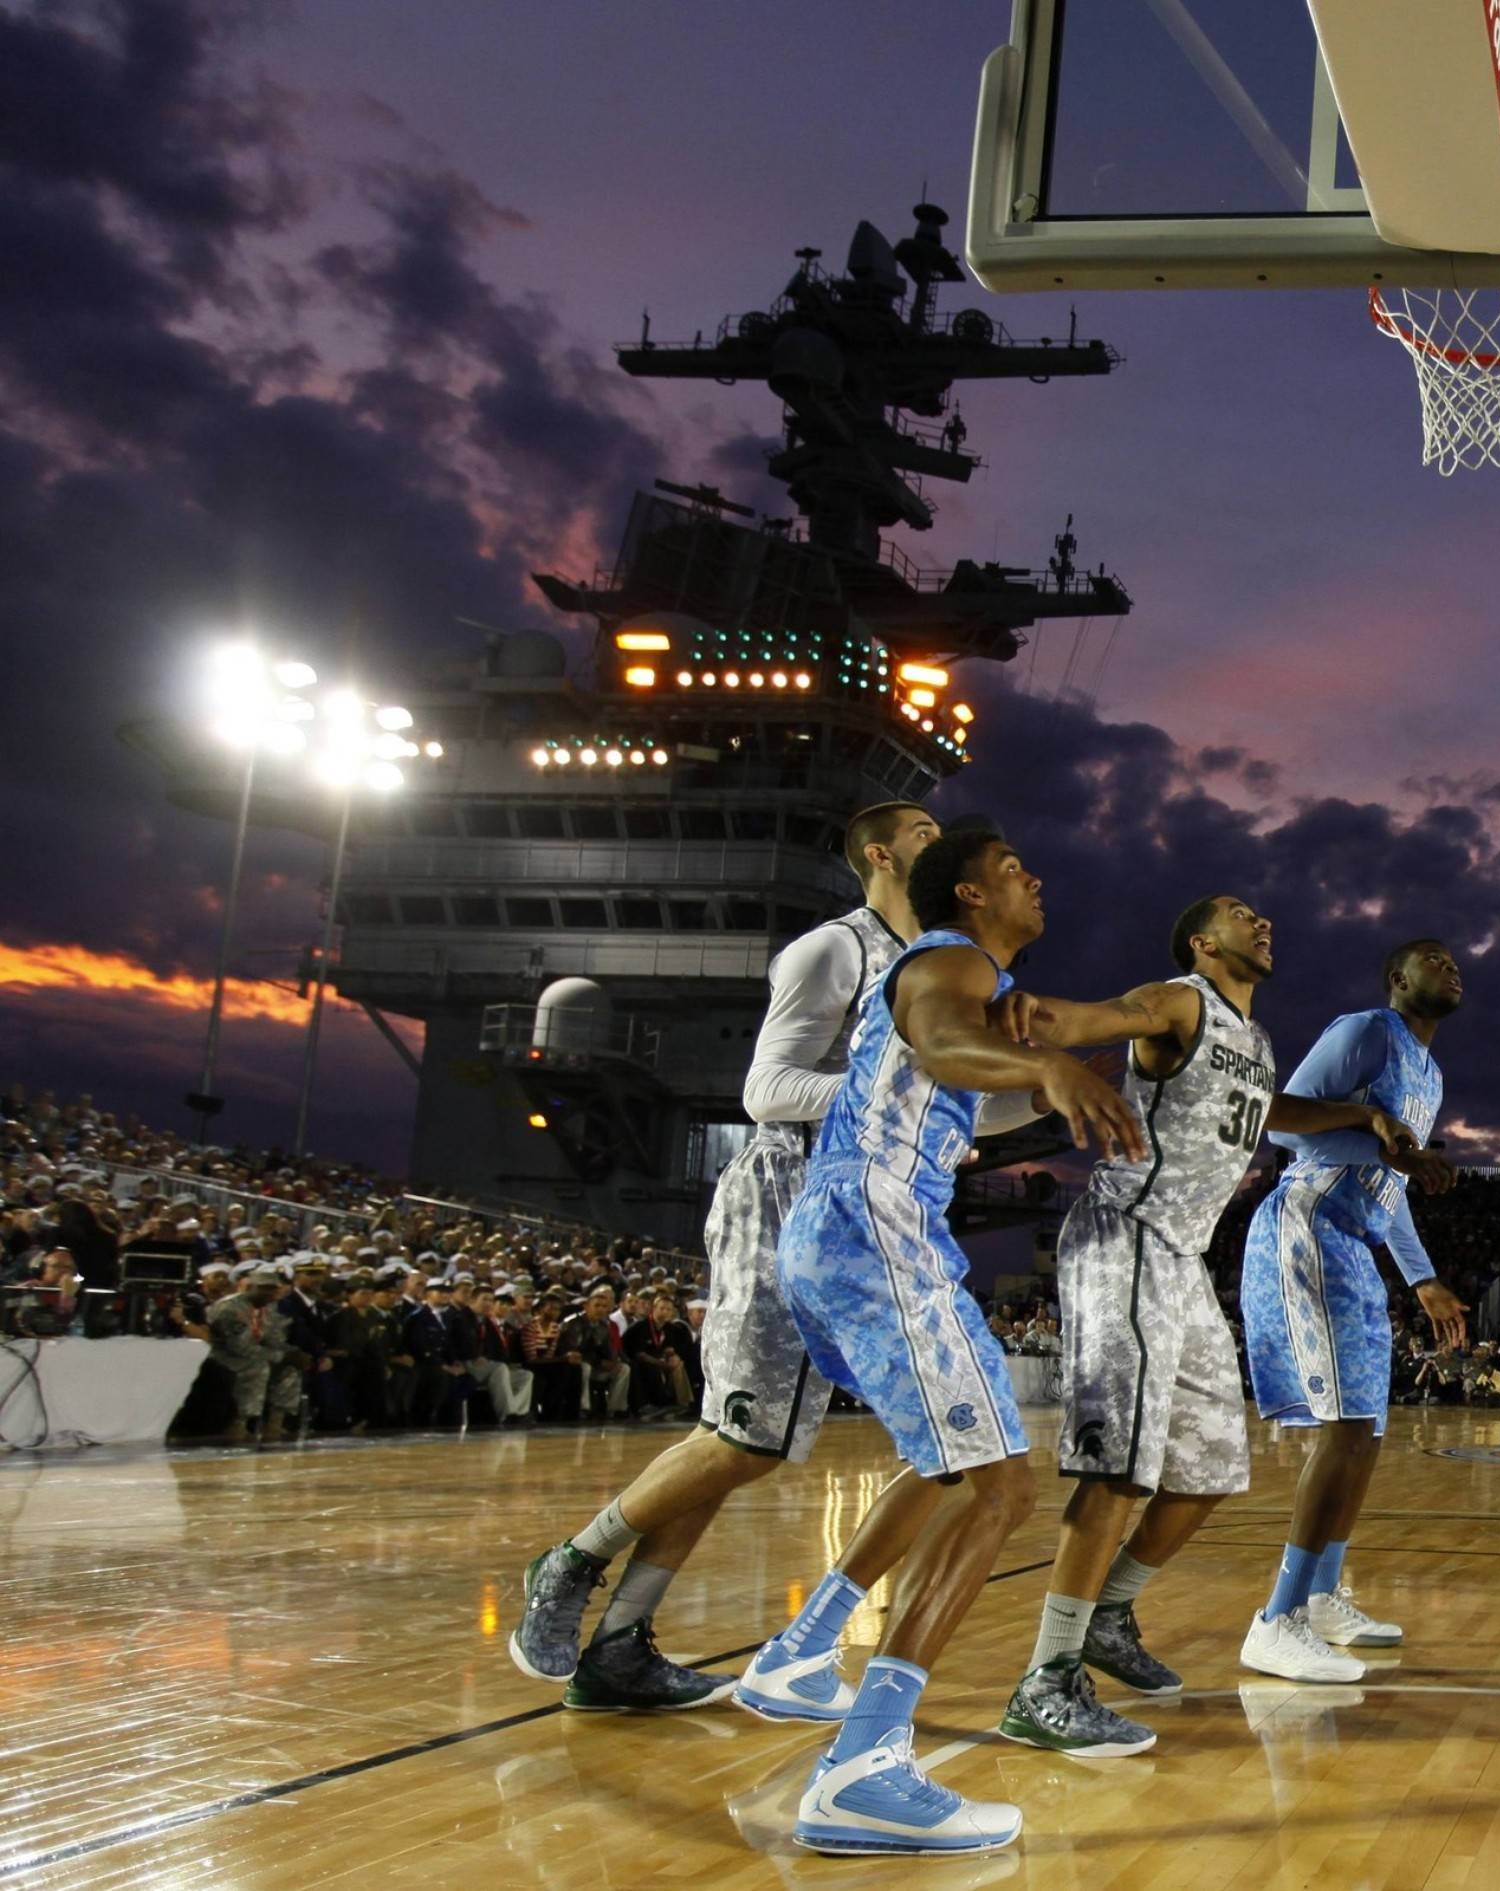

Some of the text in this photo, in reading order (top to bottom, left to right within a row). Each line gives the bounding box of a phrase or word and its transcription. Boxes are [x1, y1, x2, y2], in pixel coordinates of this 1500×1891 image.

[1209, 1043, 1276, 1094] SPARTAN
[1217, 1089, 1263, 1153] 30
[1401, 1093, 1434, 1138] NORT
